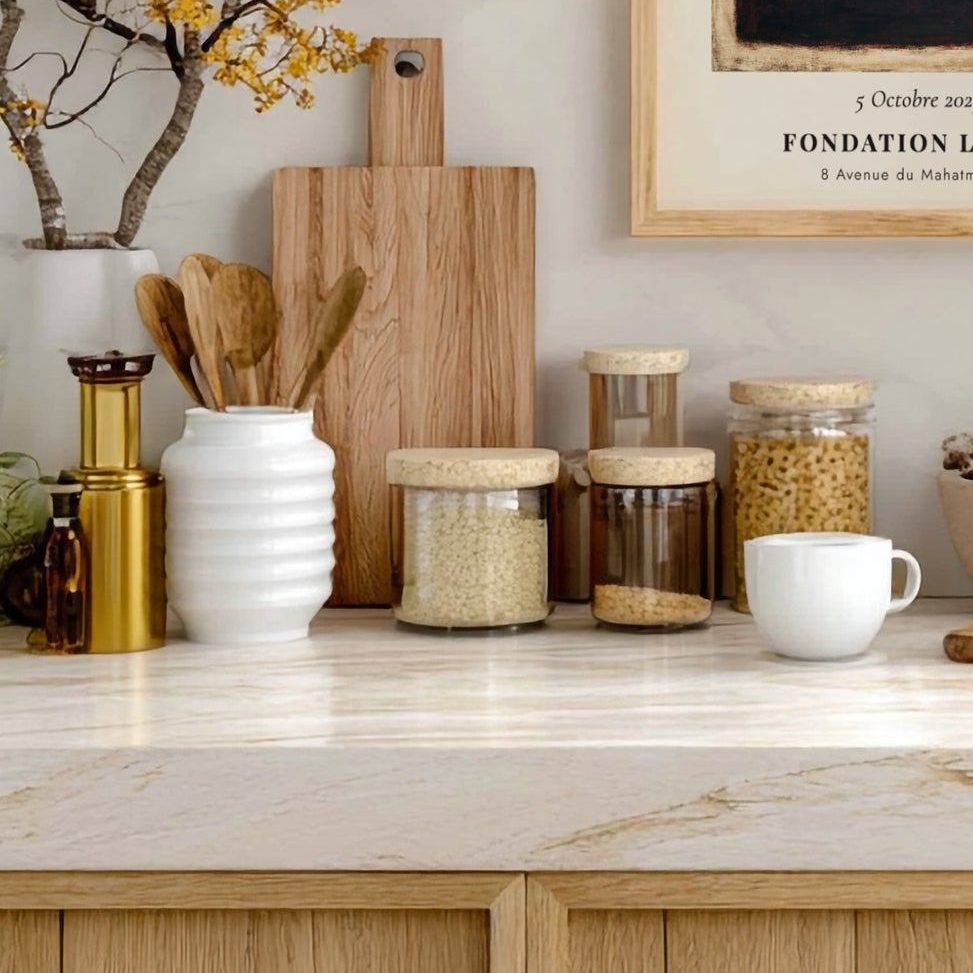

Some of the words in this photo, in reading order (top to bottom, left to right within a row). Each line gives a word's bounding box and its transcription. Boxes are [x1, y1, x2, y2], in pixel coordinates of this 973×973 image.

[855, 94, 866, 114] 5
[871, 88, 939, 108] Octobre
[782, 132, 948, 154] FONDATION
[820, 167, 829, 182] 8
[835, 168, 889, 182] Avenue
[896, 167, 914, 182] du
